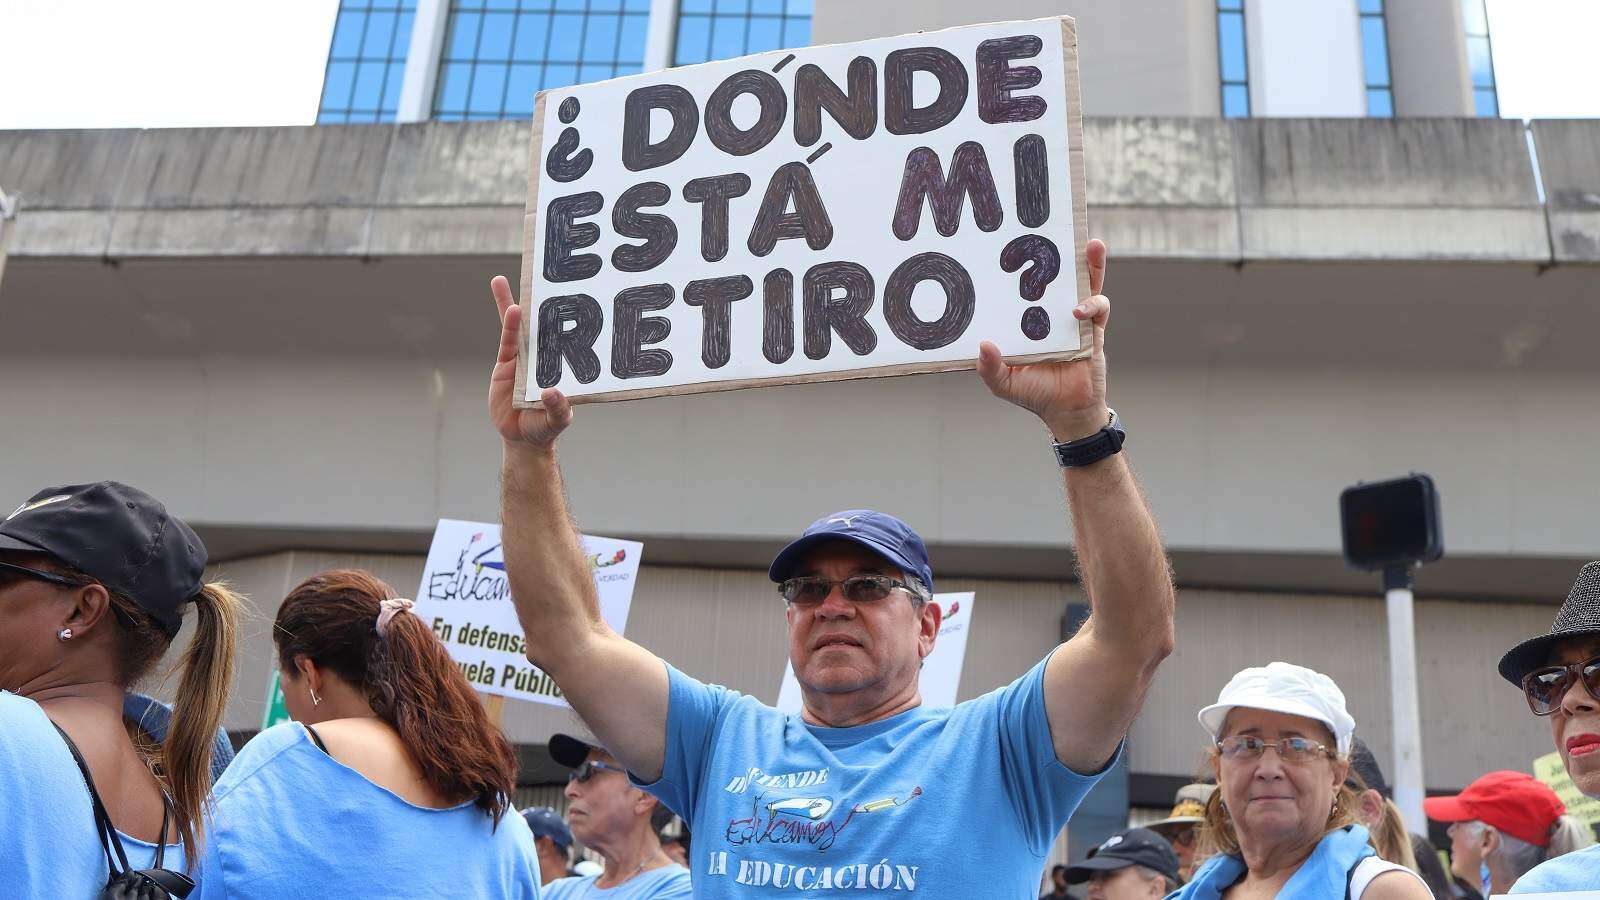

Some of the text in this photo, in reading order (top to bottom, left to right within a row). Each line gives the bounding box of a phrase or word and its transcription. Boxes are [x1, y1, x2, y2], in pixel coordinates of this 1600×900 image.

[543, 133, 1050, 283] ESTÁ MI
[536, 251, 976, 388] RETIRO
[501, 664, 561, 698] Públic
[735, 858, 919, 891] EDUCACIÓN
